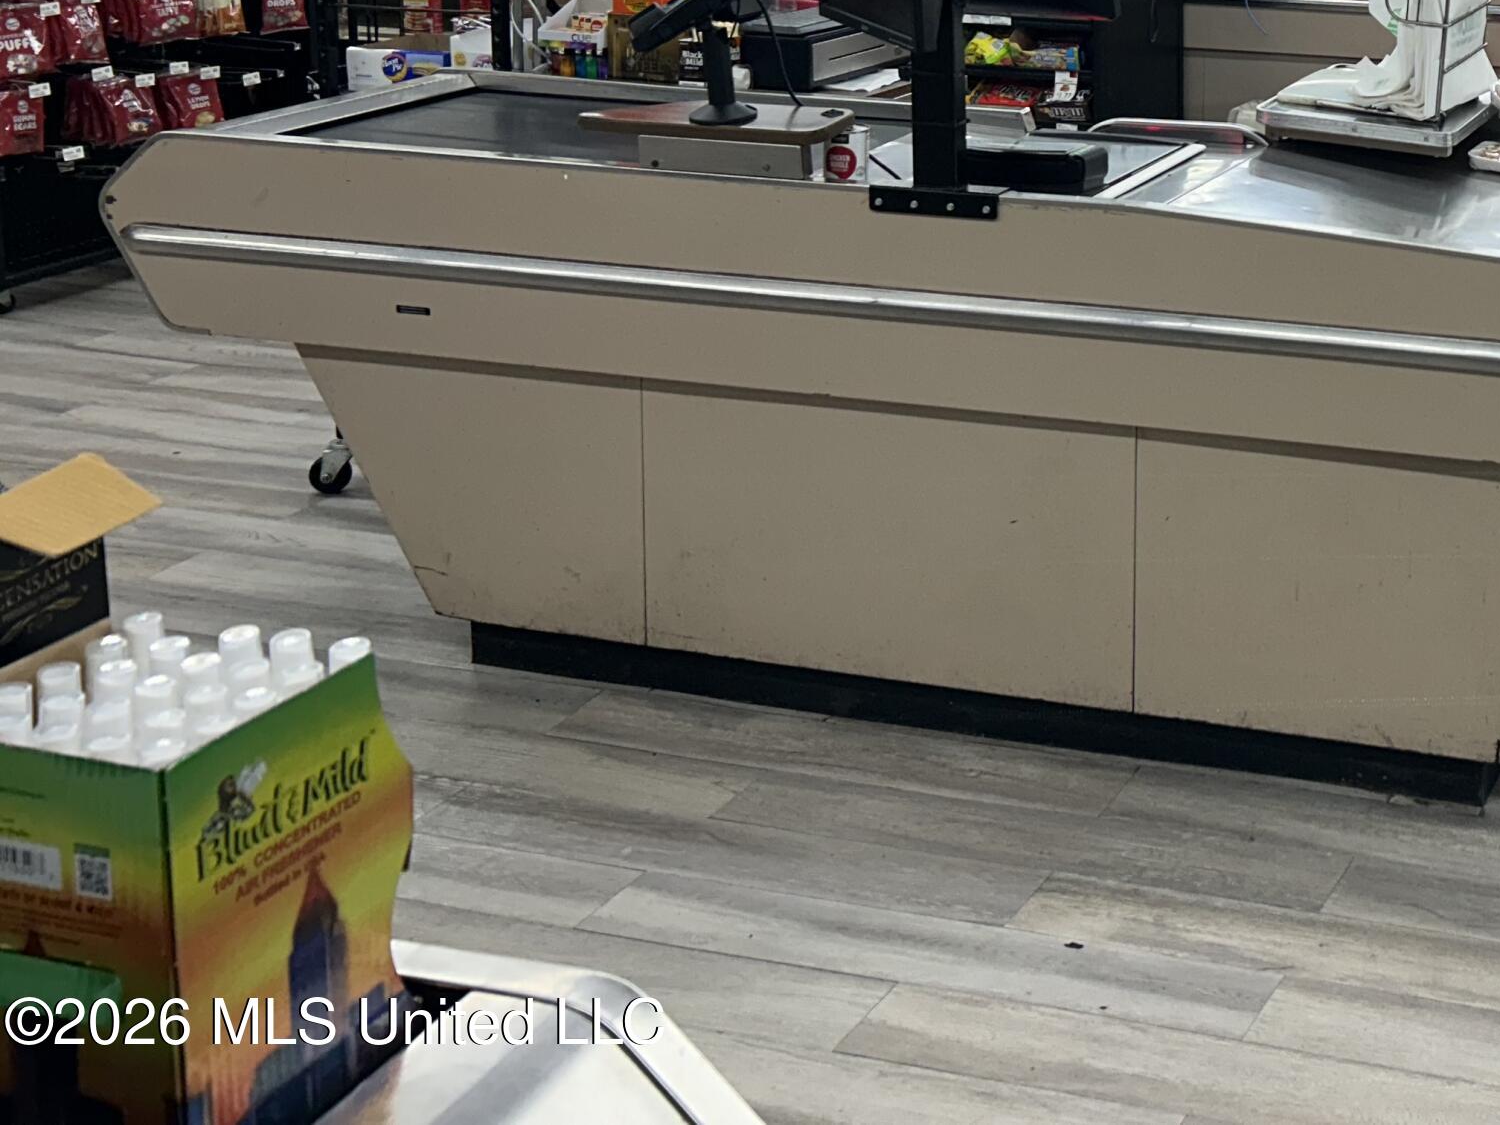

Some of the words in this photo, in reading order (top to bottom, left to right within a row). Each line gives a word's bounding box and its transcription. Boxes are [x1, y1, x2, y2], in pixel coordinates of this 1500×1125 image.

[267, 0, 296, 8] DROPS
[0, 541, 98, 611] ENSATION
[253, 791, 361, 868] CONCENTRATED
